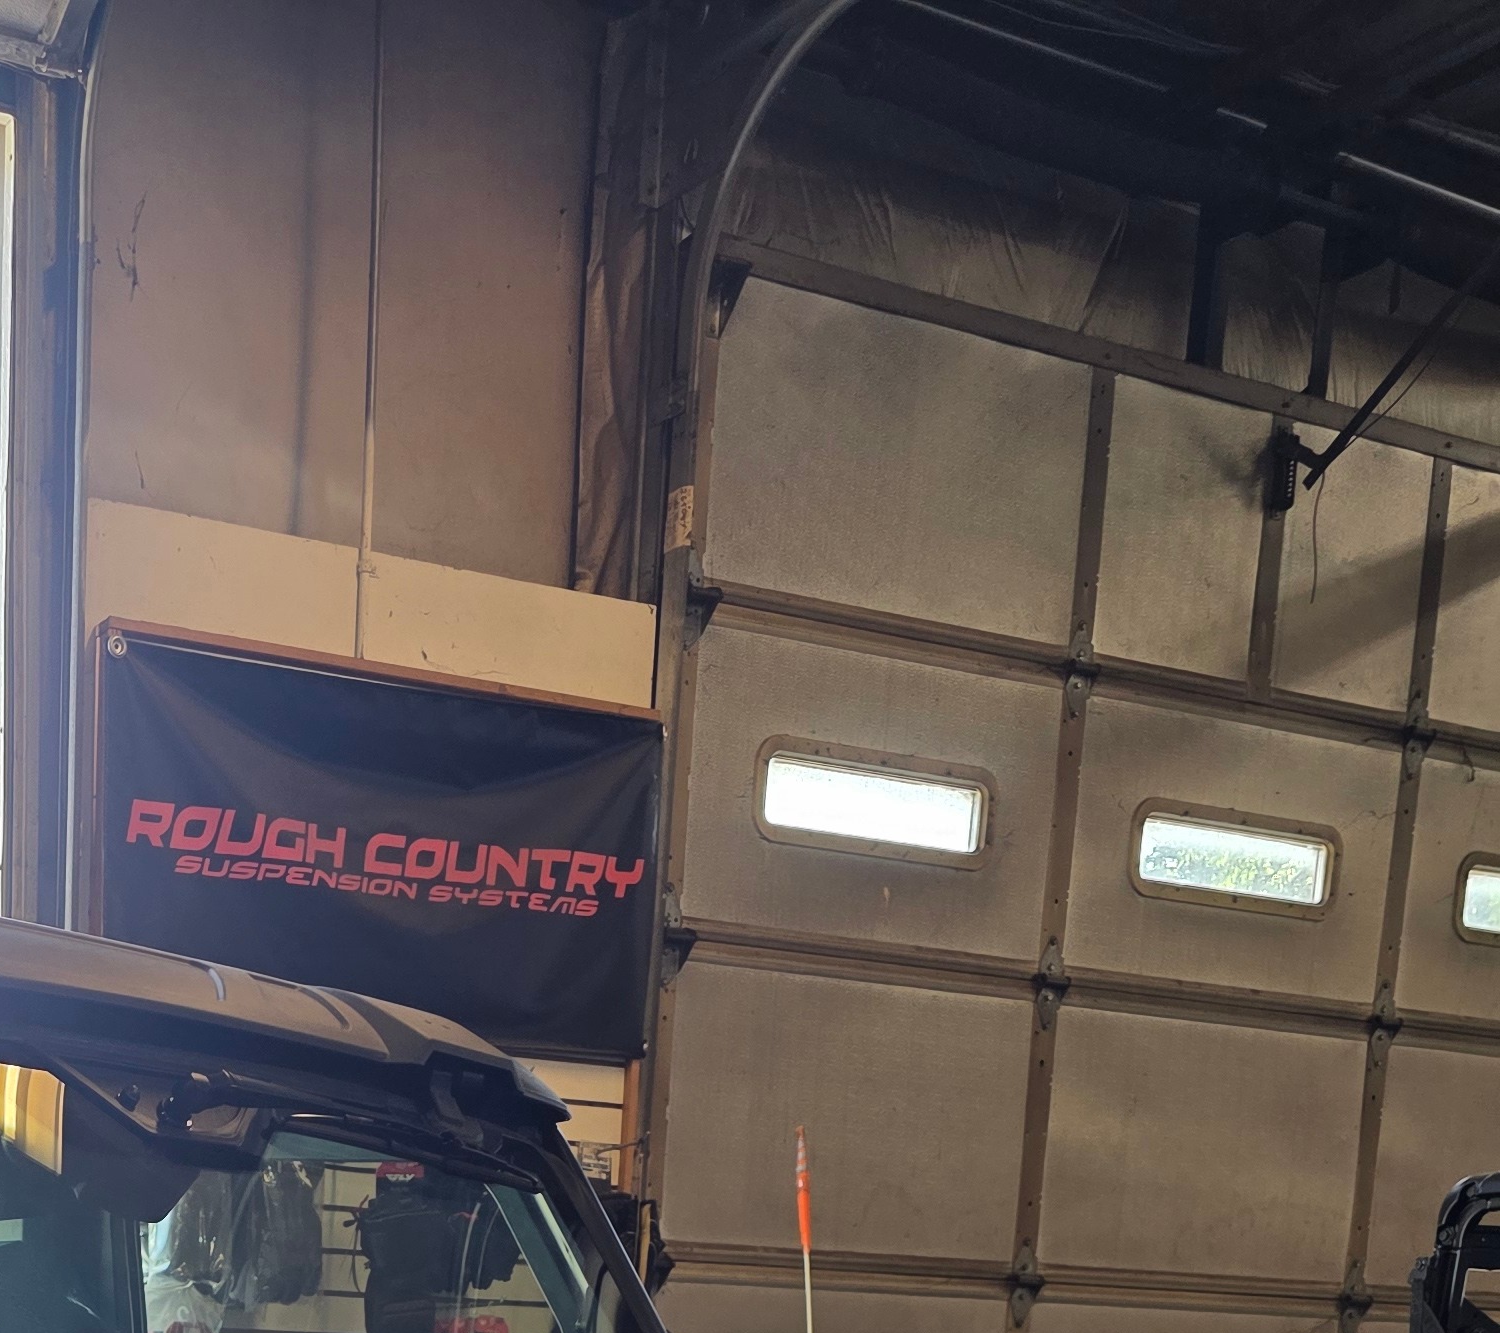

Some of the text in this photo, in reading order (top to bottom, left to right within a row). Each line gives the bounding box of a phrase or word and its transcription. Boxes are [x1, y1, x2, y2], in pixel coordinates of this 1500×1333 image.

[126, 799, 645, 898] ROUGH COUNTRY
[174, 855, 599, 917] SUSPENSION SYSTEMS
